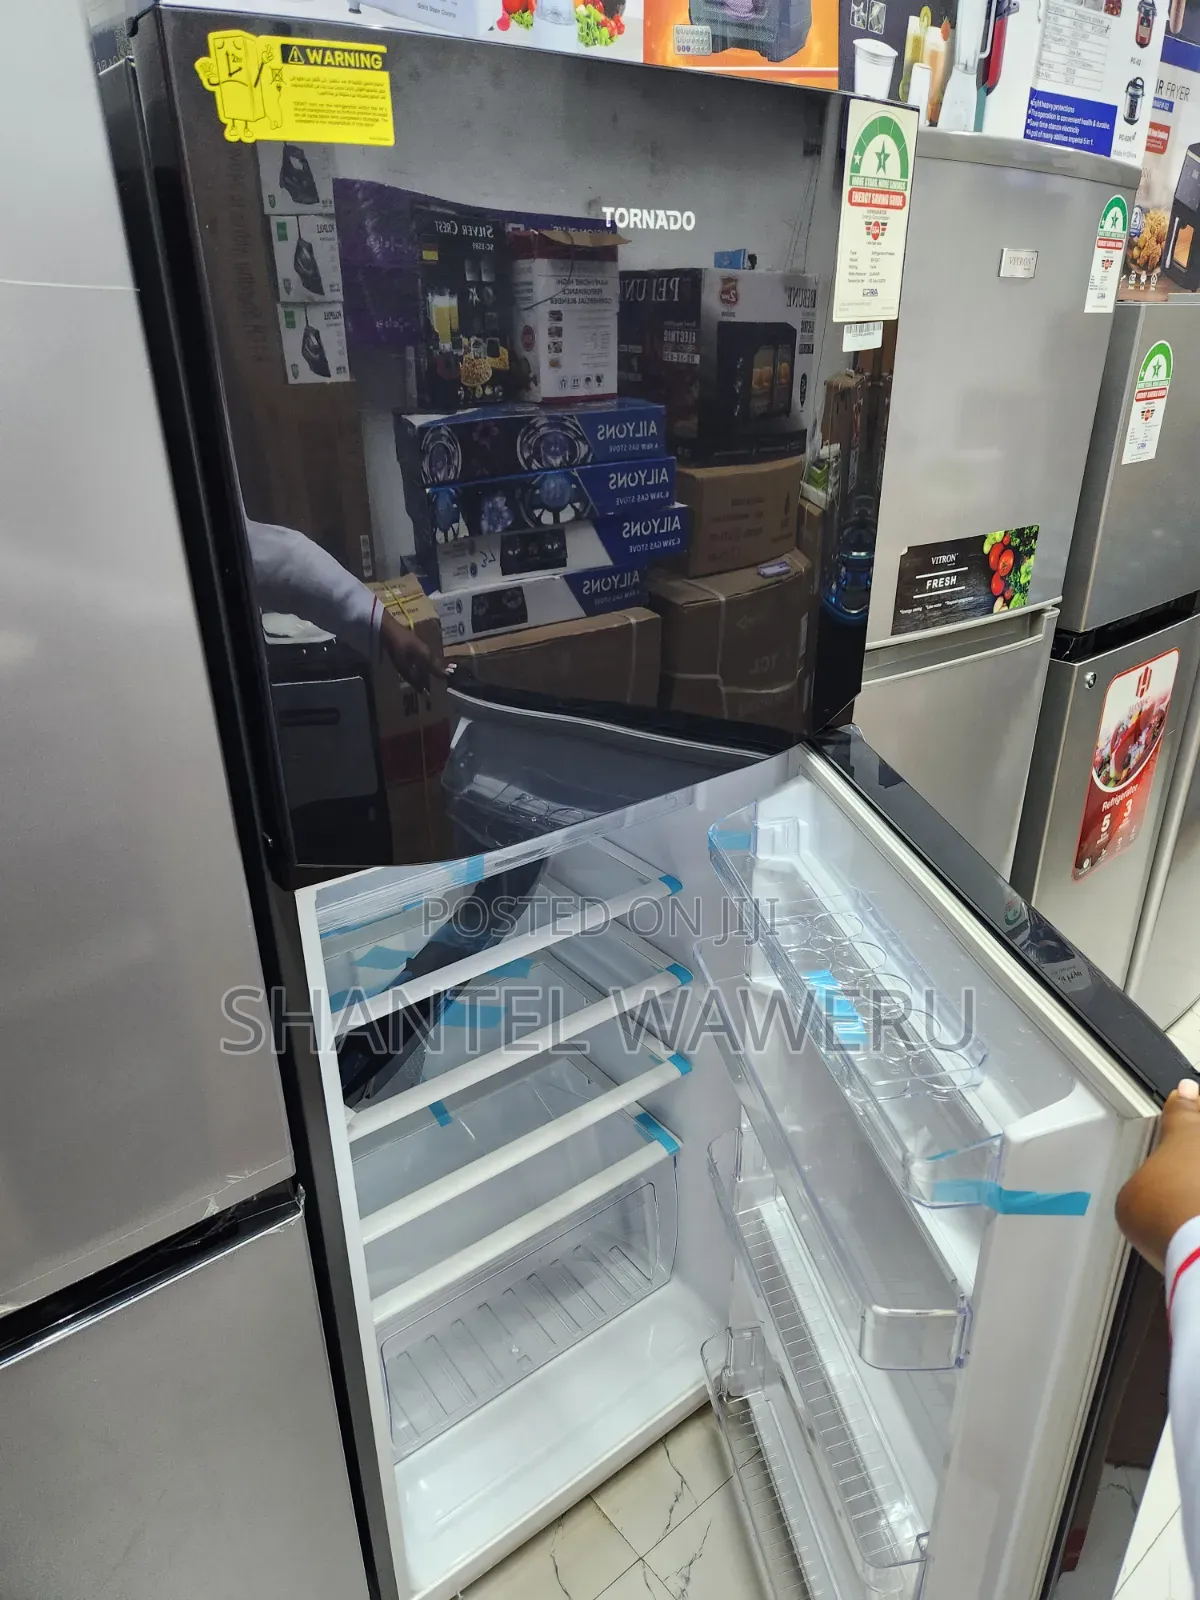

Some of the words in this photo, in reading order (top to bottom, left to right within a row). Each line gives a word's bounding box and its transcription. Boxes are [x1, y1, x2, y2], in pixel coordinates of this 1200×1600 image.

[306, 48, 382, 69] WARNING
[1155, 78, 1164, 96] IR
[1165, 82, 1190, 102] FRYER
[852, 191, 871, 203] ENERGY
[871, 193, 889, 205] SAVING
[889, 194, 903, 206] GUIDE
[602, 206, 696, 231] TORNADO
[931, 553, 957, 565] VITRON
[926, 575, 957, 590] FRESH
[1101, 782, 1139, 813] Refrigerator
[1124, 798, 1133, 818] 3
[1101, 813, 1110, 832] 5
